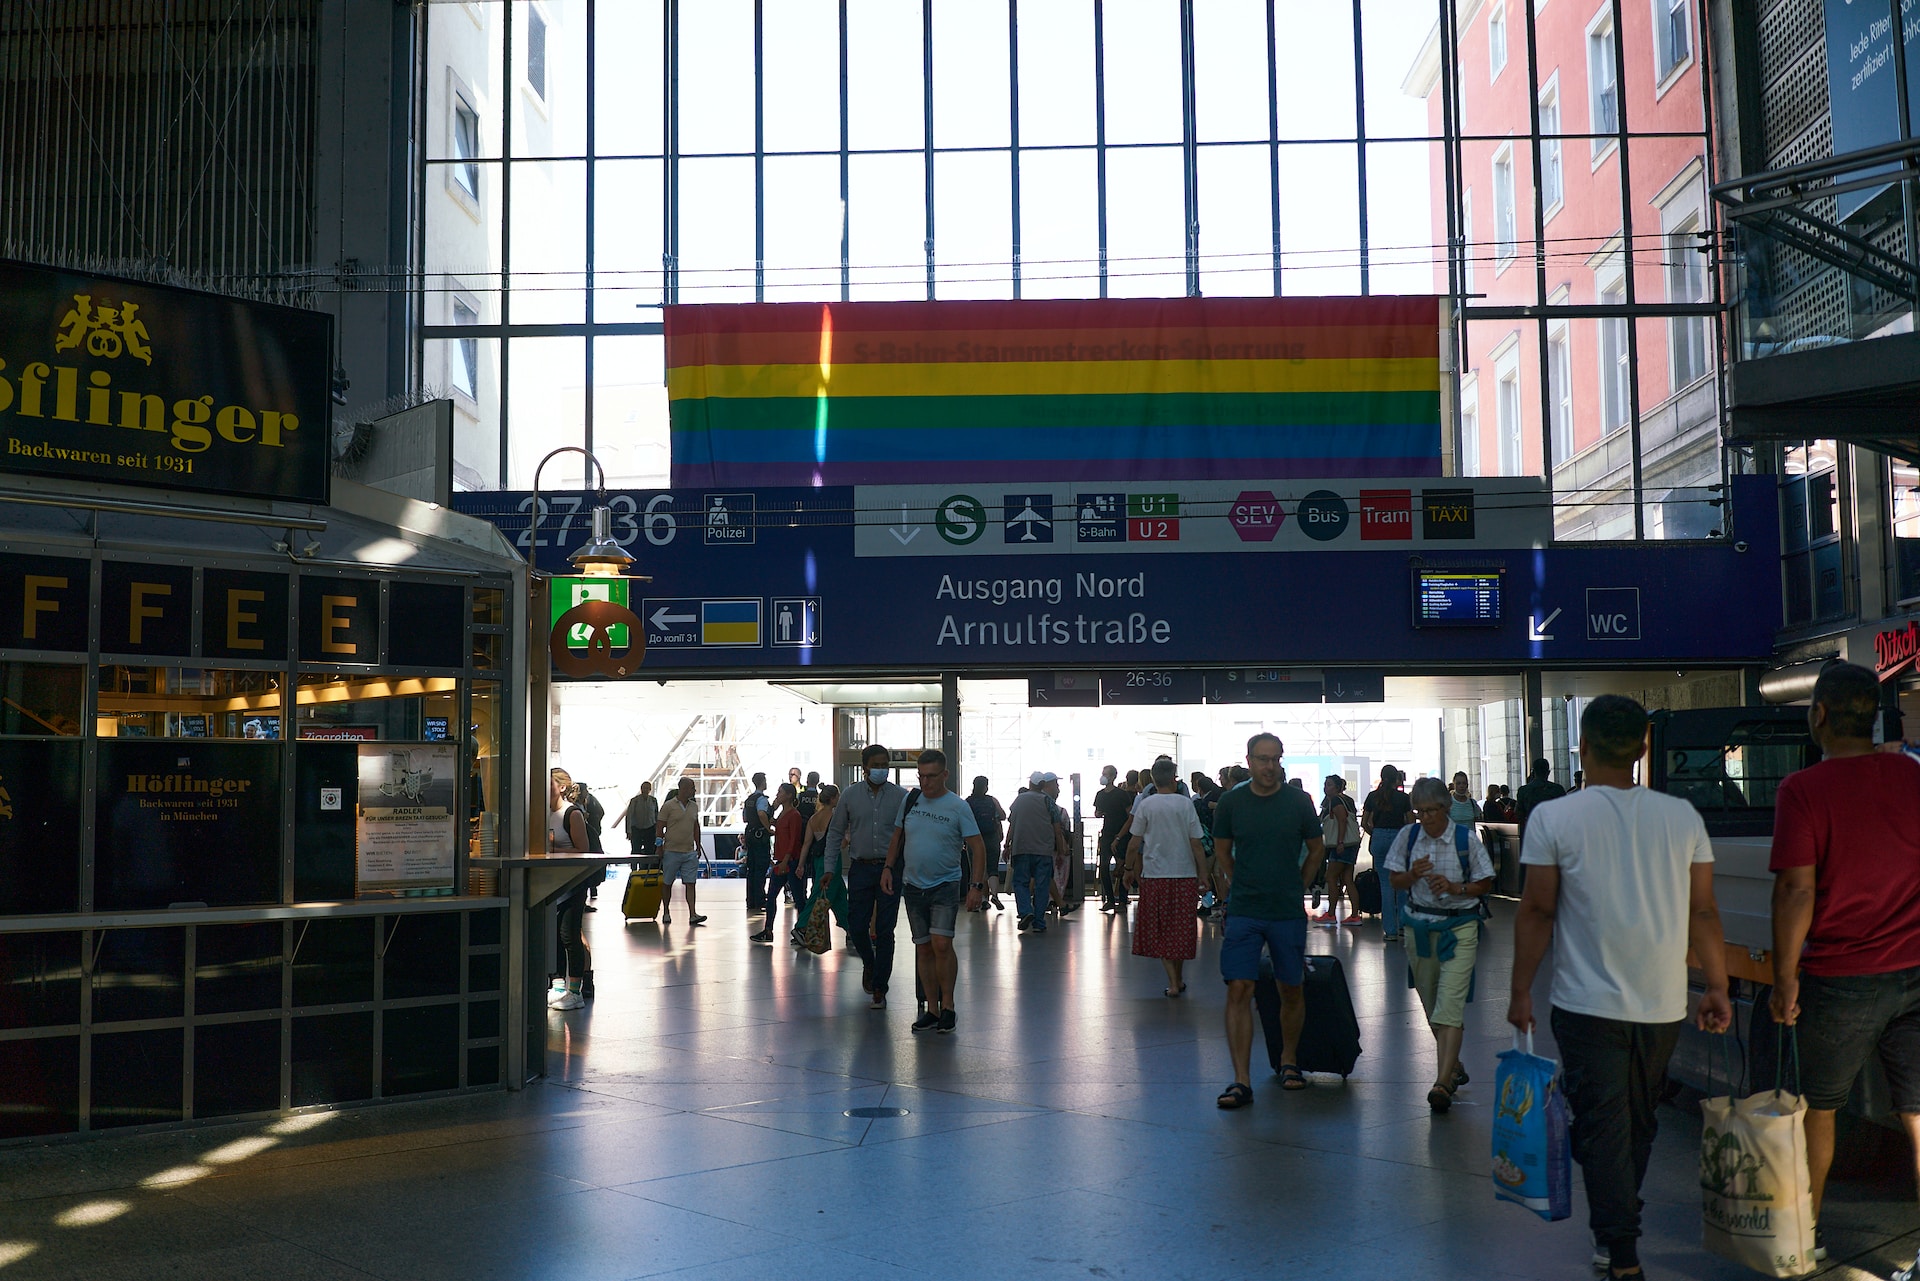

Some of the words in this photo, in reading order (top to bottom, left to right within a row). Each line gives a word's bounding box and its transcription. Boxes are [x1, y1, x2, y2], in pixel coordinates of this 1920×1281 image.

[1850, 32, 1869, 63] Jede
[1852, 44, 1889, 90] zertifiziert
[8, 438, 111, 464] Backwaren
[117, 453, 148, 469] seit
[154, 455, 194, 473] 1931
[944, 499, 977, 540] S
[1236, 505, 1275, 525] SEV
[1308, 507, 1340, 524] Bus
[1363, 507, 1410, 524] Tram
[1428, 506, 1468, 522] TAXI
[707, 527, 746, 540] Polizei
[1079, 527, 1117, 538] S-Bahn
[936, 574, 1062, 605] Ausgang
[1076, 572, 1145, 598] Nord
[936, 612, 1172, 645] Arnulfstraße
[1590, 614, 1628, 634] WC
[649, 634, 662, 644] До
[686, 634, 697, 642] 31
[1874, 620, 1917, 673] Ditsch
[1126, 672, 1172, 687] 26-36
[1672, 752, 1690, 774] 2
[127, 774, 251, 797] Höflinger
[139, 799, 194, 808] Backwaren
[217, 799, 238, 808] 1931
[160, 812, 170, 821] in
[173, 811, 218, 821] München
